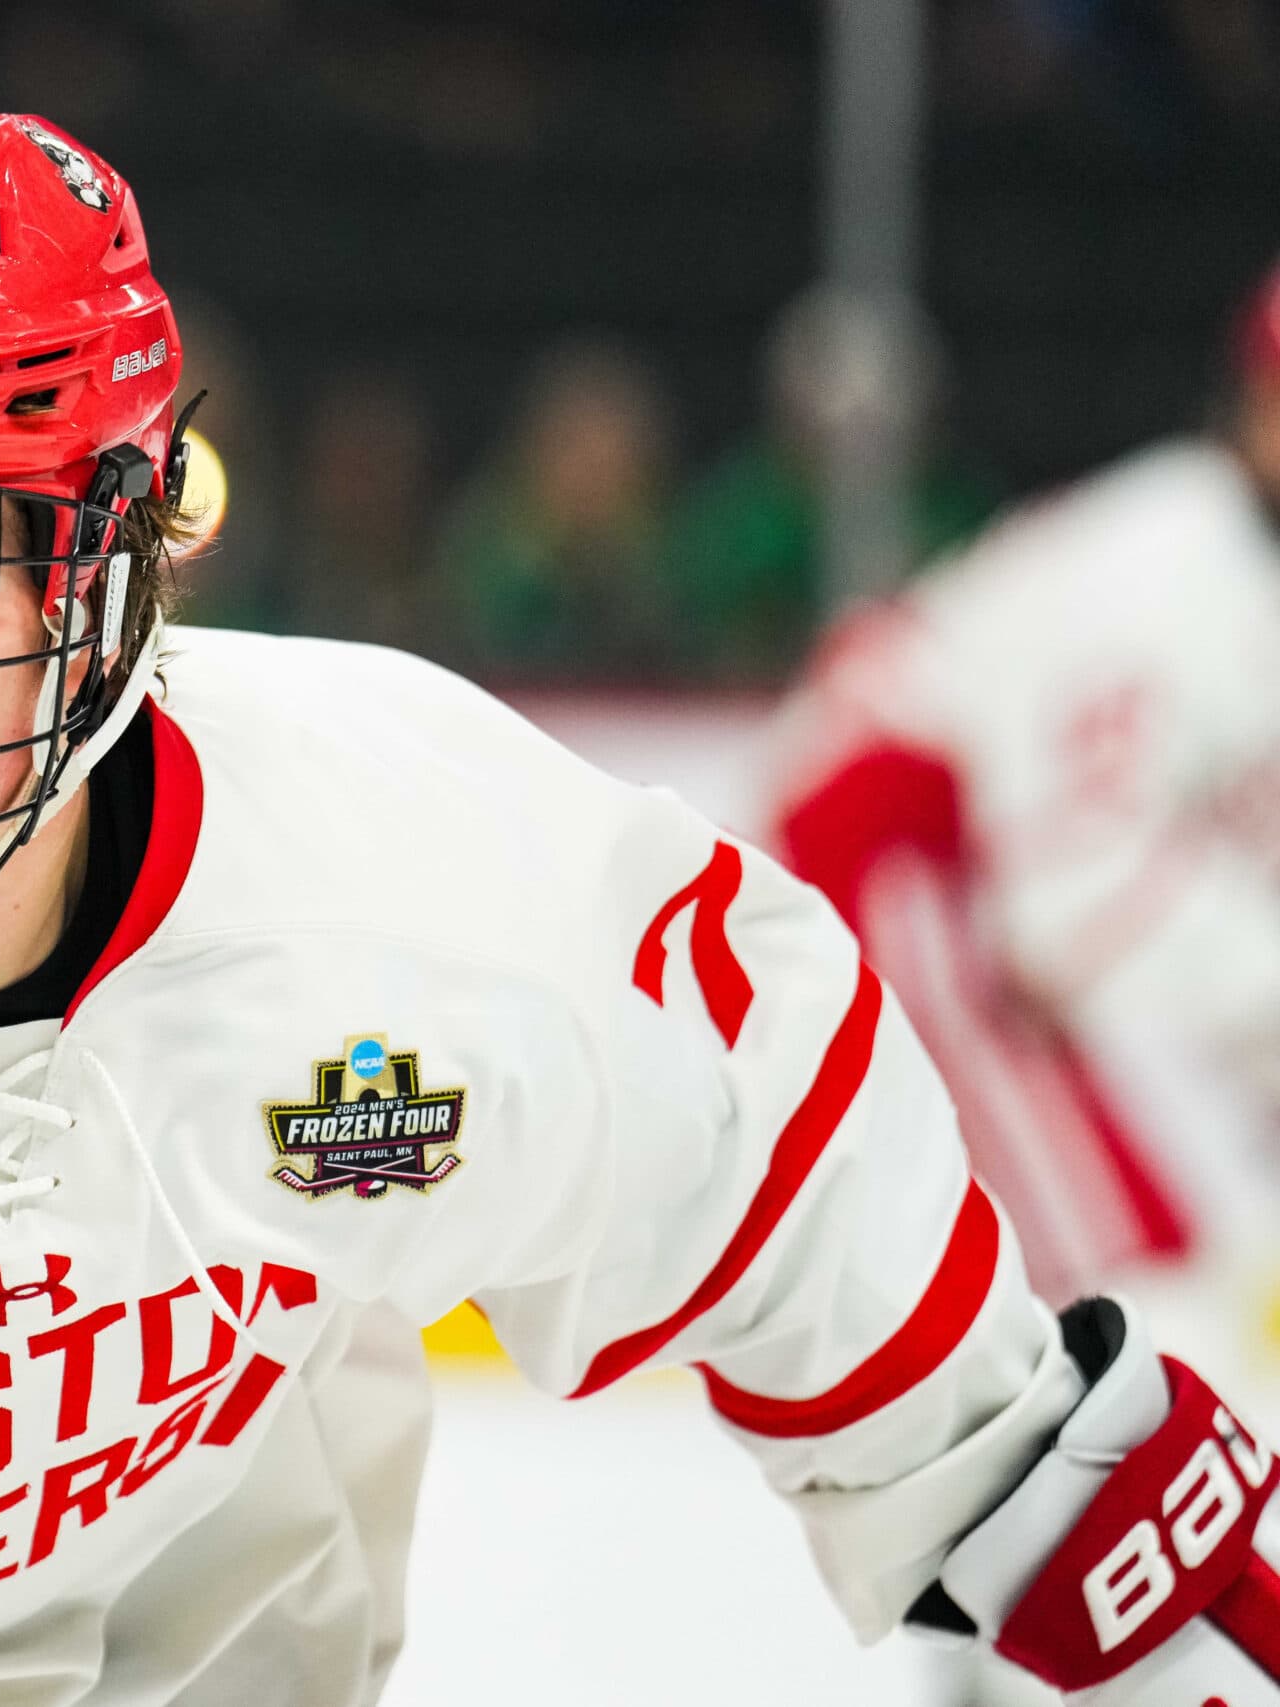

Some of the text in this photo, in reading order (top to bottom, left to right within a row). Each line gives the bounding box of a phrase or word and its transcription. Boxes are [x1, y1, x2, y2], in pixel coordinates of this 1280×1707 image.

[354, 1057, 385, 1070] NCAA
[334, 1098, 404, 1116] 2024 MEN'S
[286, 1104, 451, 1144] FROZEN FOUR
[326, 1145, 413, 1162] SAINT PAUL, MN
